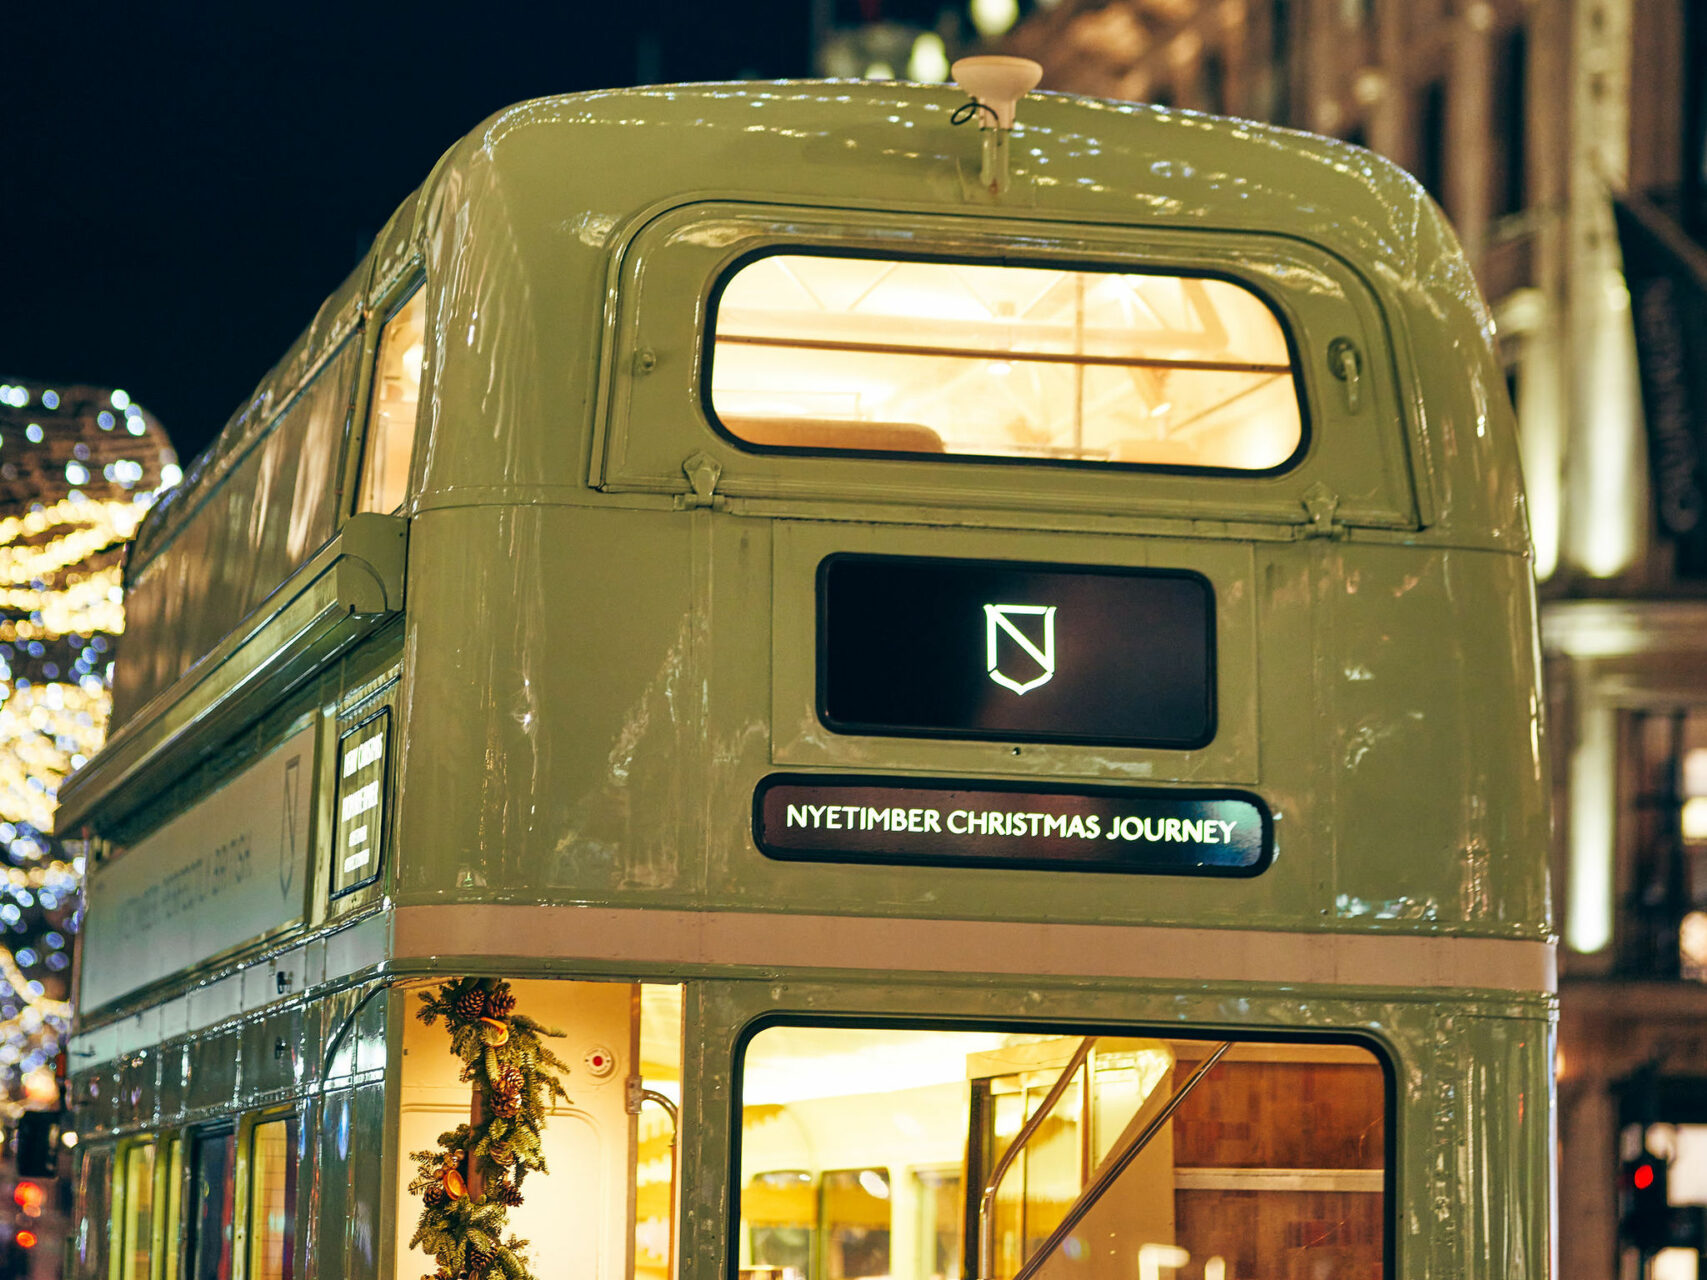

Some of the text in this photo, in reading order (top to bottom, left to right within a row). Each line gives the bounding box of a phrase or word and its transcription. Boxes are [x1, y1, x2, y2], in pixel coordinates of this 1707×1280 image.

[786, 803, 1237, 845] NYETIMBER CHRISTMAS JOURNEY
